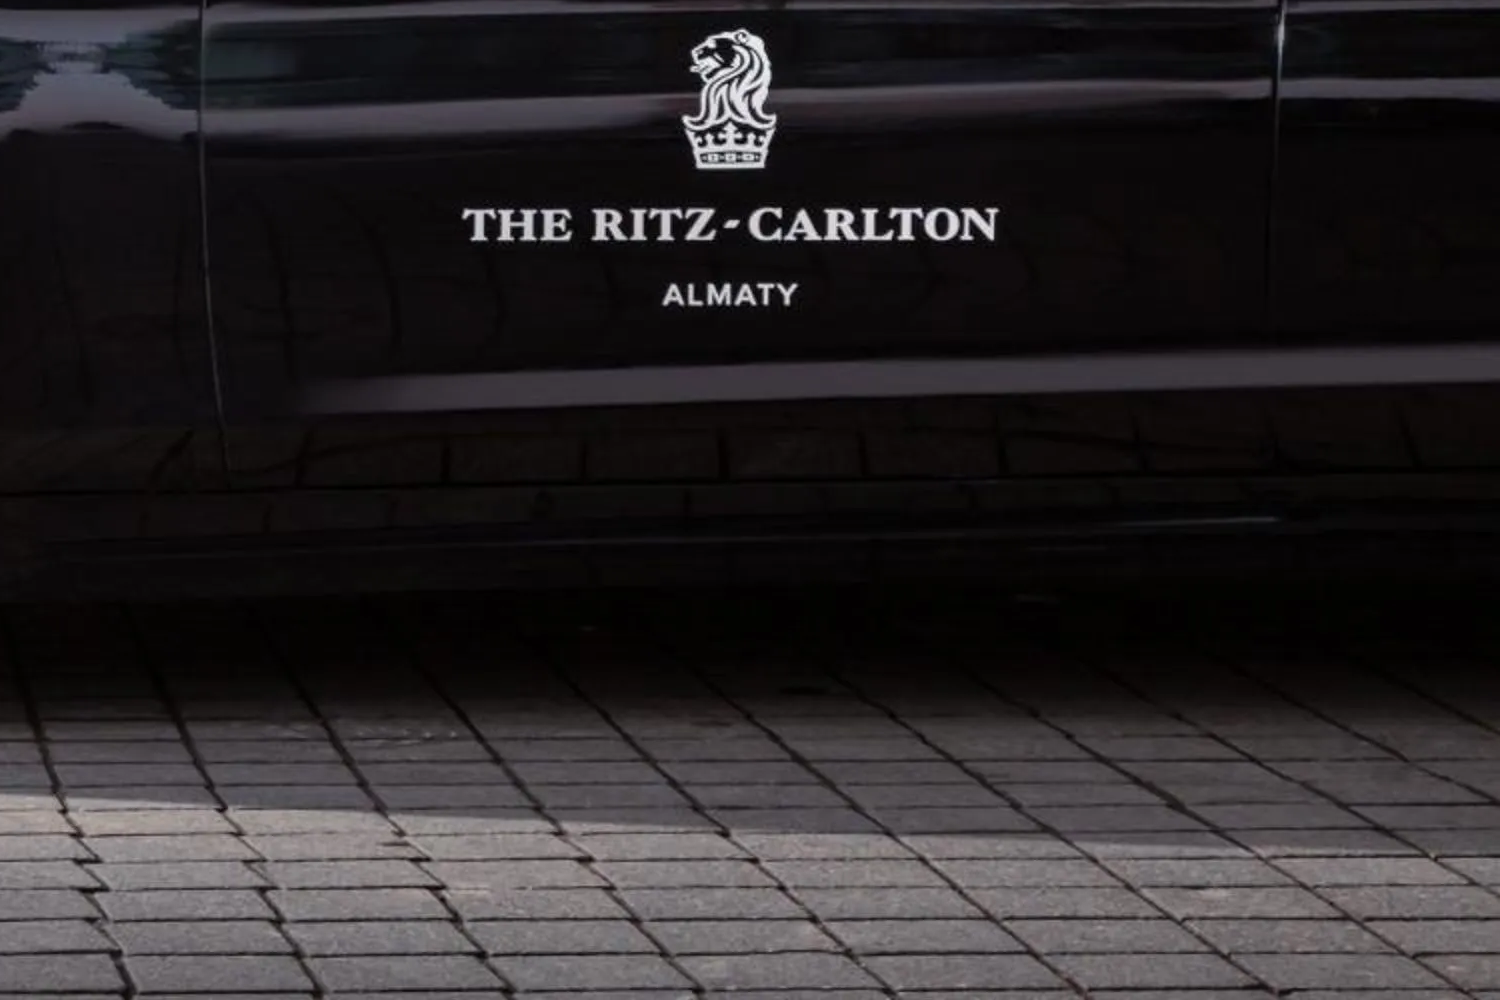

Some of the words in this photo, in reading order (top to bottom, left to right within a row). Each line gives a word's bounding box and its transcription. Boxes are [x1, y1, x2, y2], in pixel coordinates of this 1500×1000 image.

[462, 208, 573, 241] THE
[591, 207, 999, 241] RITZ-CARLTON
[662, 283, 798, 307] ALMATY
